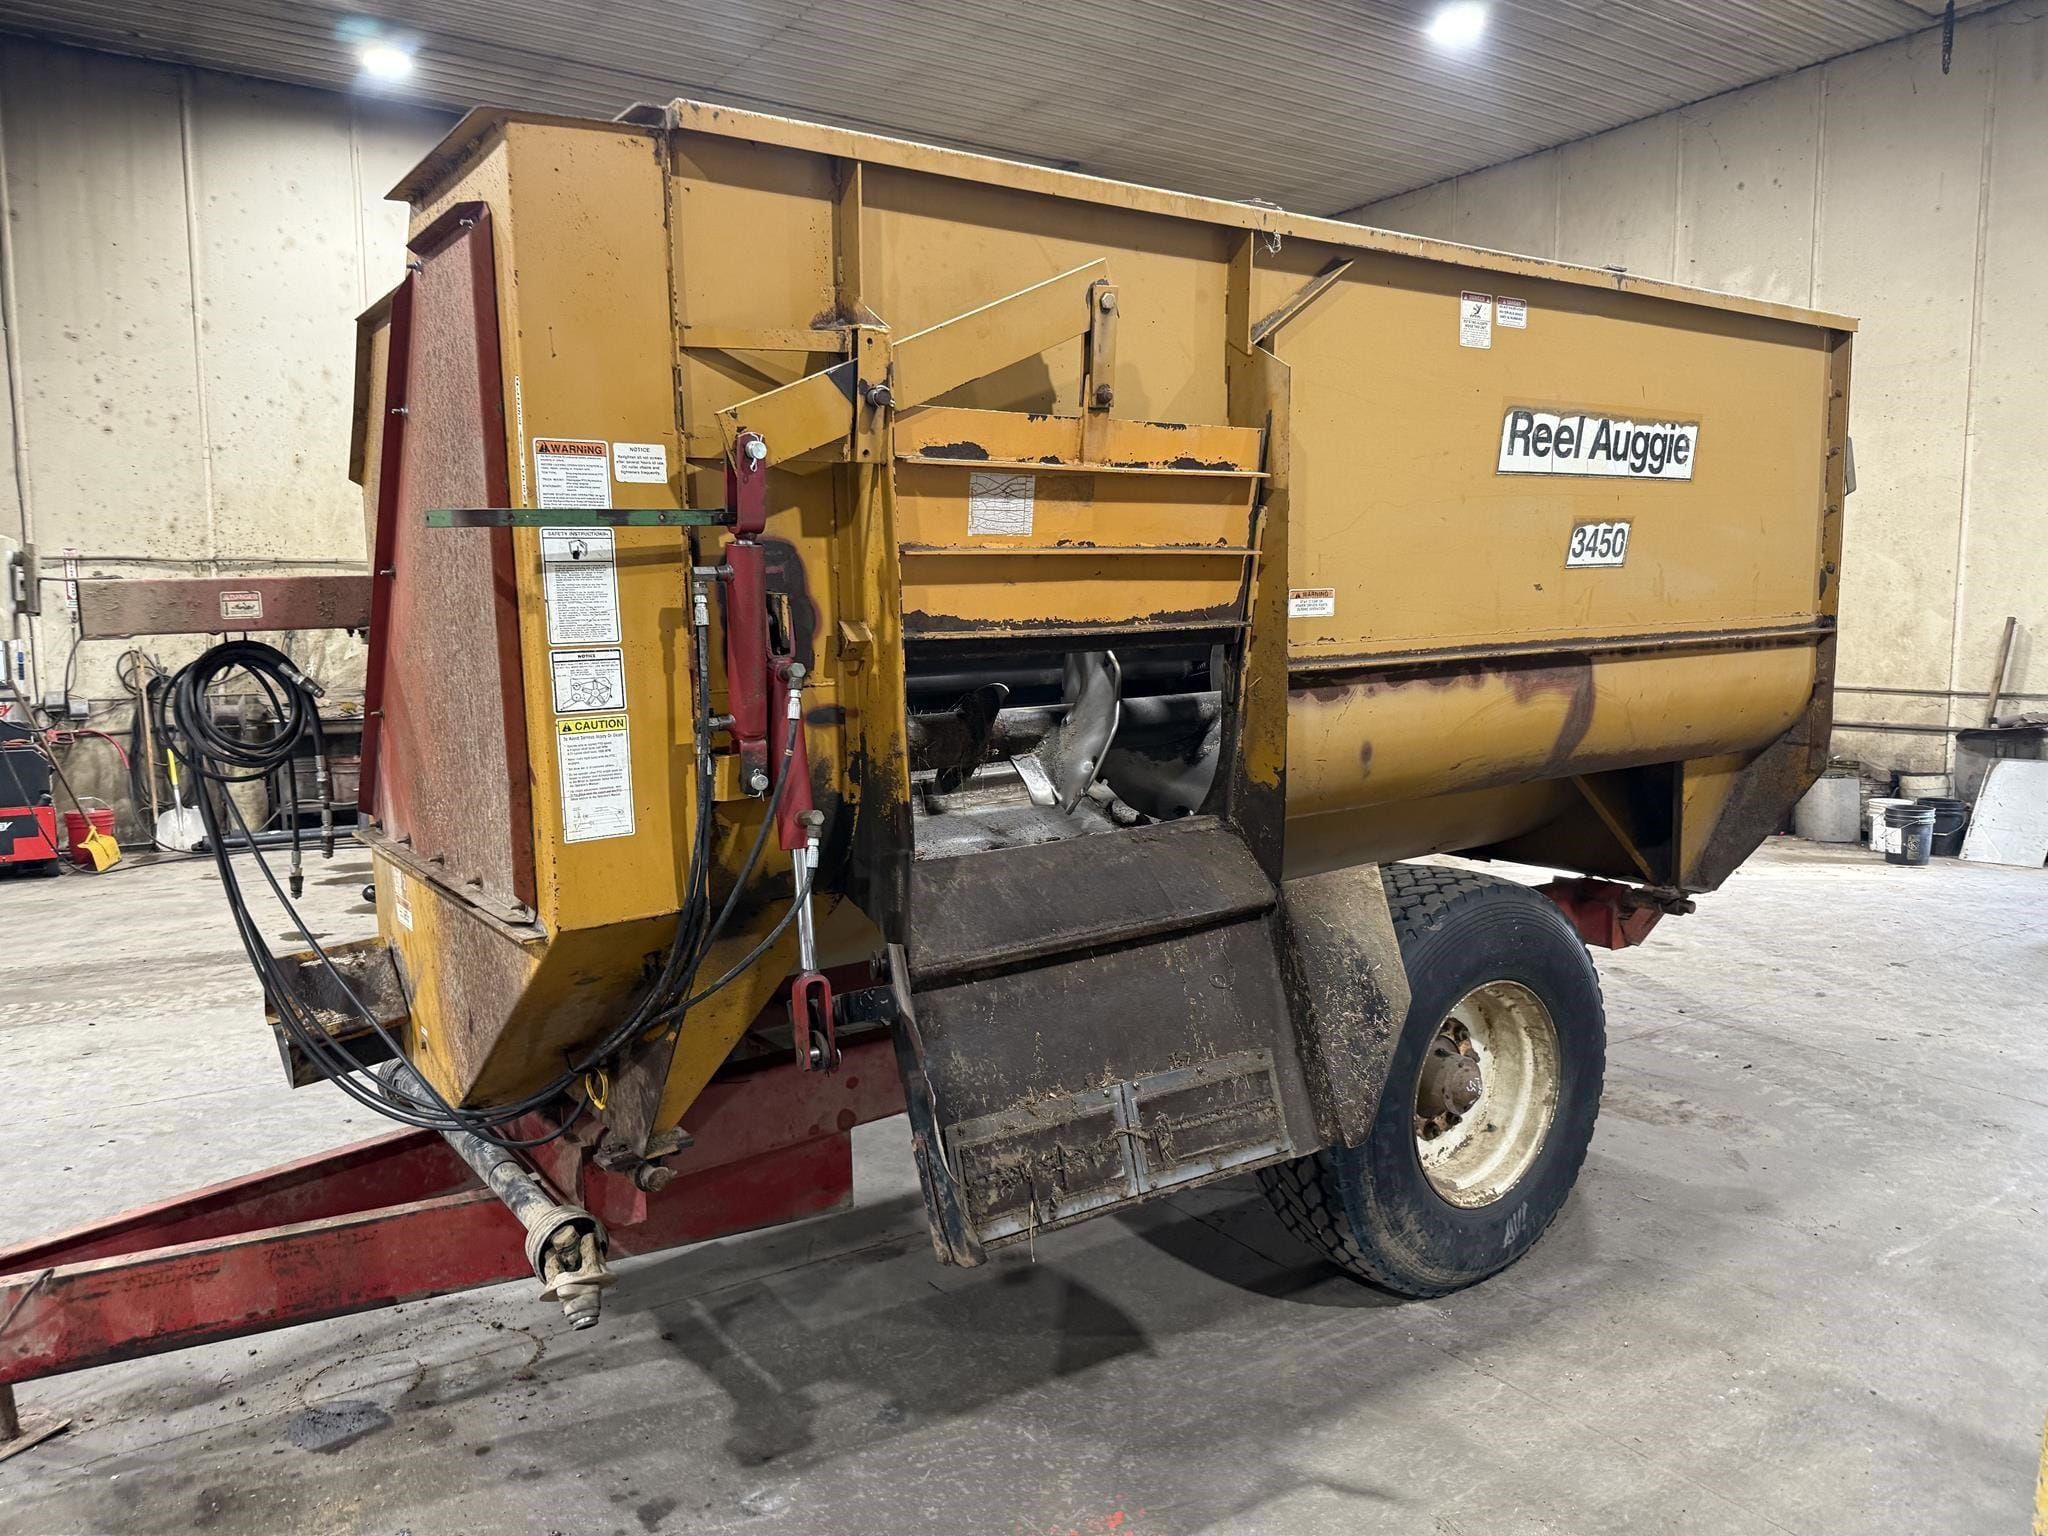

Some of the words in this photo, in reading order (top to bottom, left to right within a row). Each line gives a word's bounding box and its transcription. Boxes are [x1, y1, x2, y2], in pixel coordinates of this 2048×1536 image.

[551, 444, 603, 455] WARNING
[1507, 411, 1586, 459] Reel
[1588, 418, 1690, 474] Auggie
[1571, 527, 1626, 557] 3450
[574, 719, 624, 731] CAUTION
